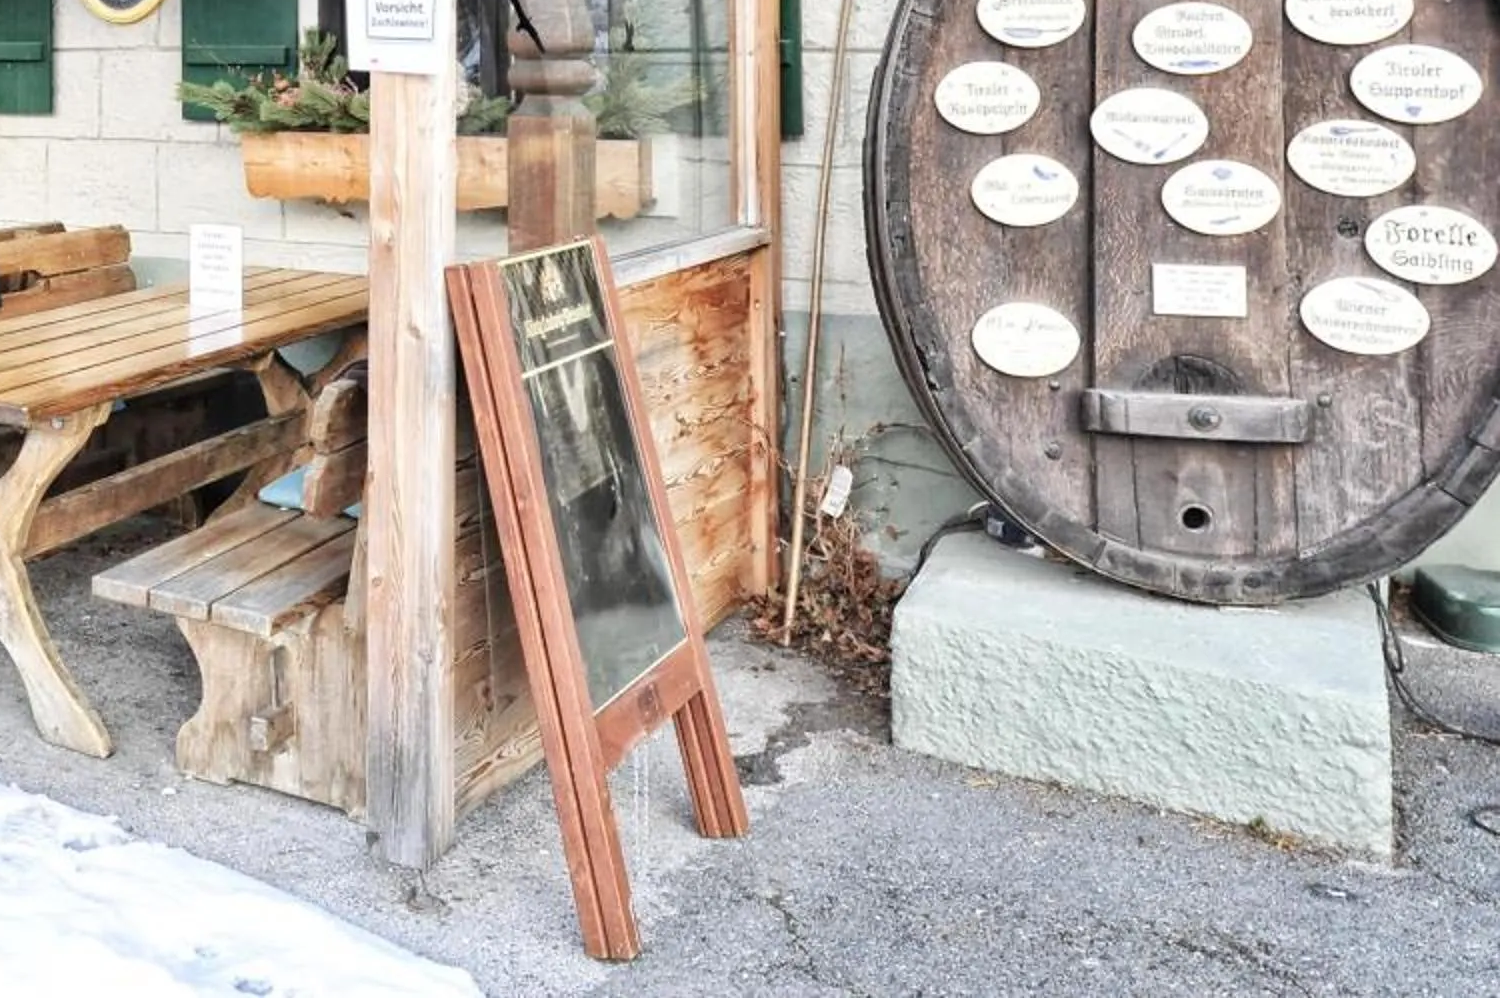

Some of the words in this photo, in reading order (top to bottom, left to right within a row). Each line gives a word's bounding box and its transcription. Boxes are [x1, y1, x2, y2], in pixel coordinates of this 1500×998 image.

[1368, 82, 1467, 101] Suppentopf
[1384, 219, 1479, 248] Forelle
[1391, 250, 1474, 275] Saibling
